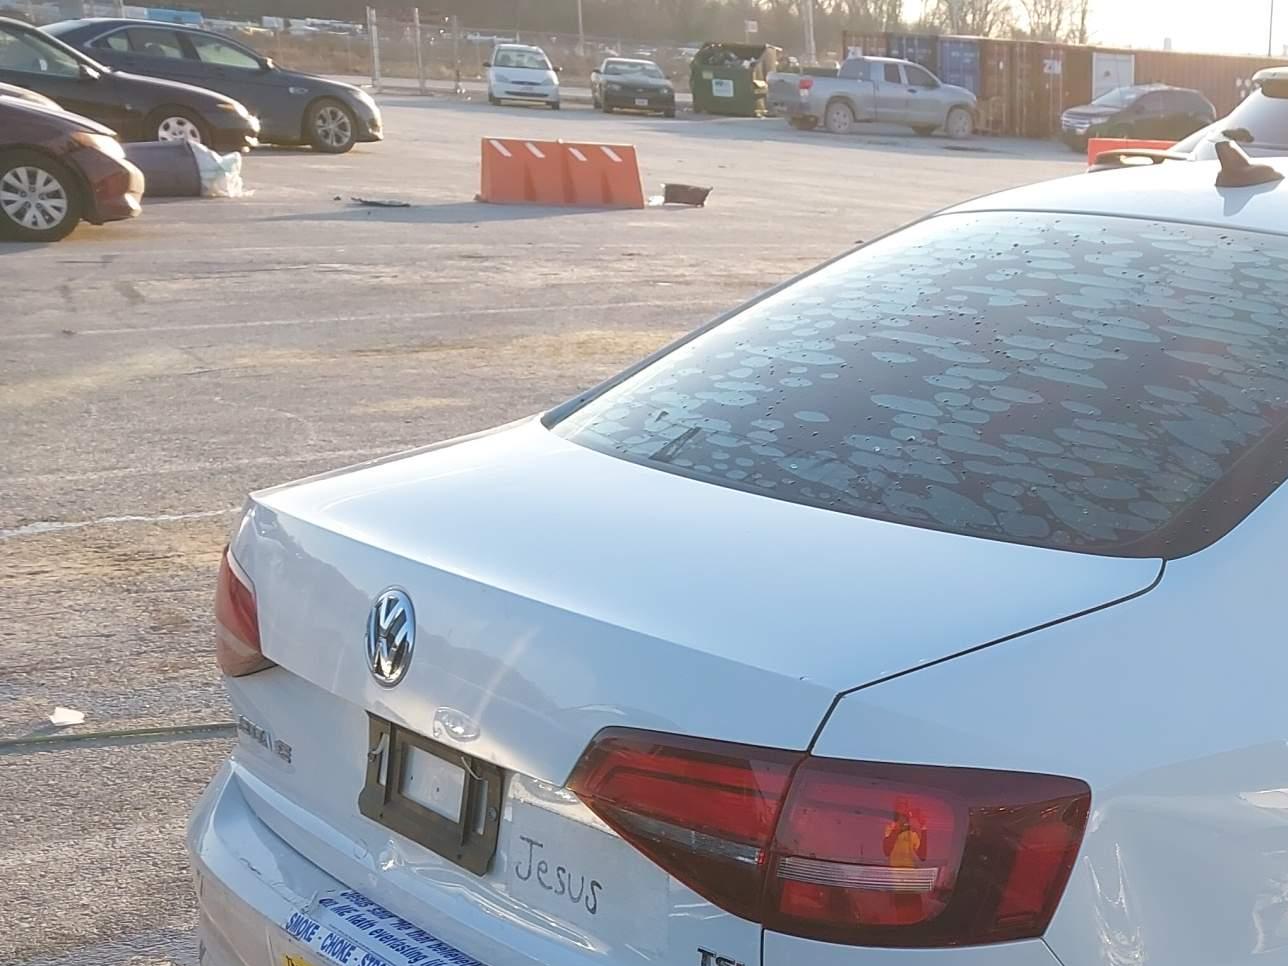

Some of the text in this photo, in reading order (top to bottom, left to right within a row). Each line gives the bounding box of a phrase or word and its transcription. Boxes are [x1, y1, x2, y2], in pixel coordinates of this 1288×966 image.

[514, 835, 603, 915] Jesus
[285, 912, 321, 943] SMOKE
[320, 932, 357, 964] CHOKE
[345, 911, 375, 931] hath
[368, 927, 426, 964] everlasting
